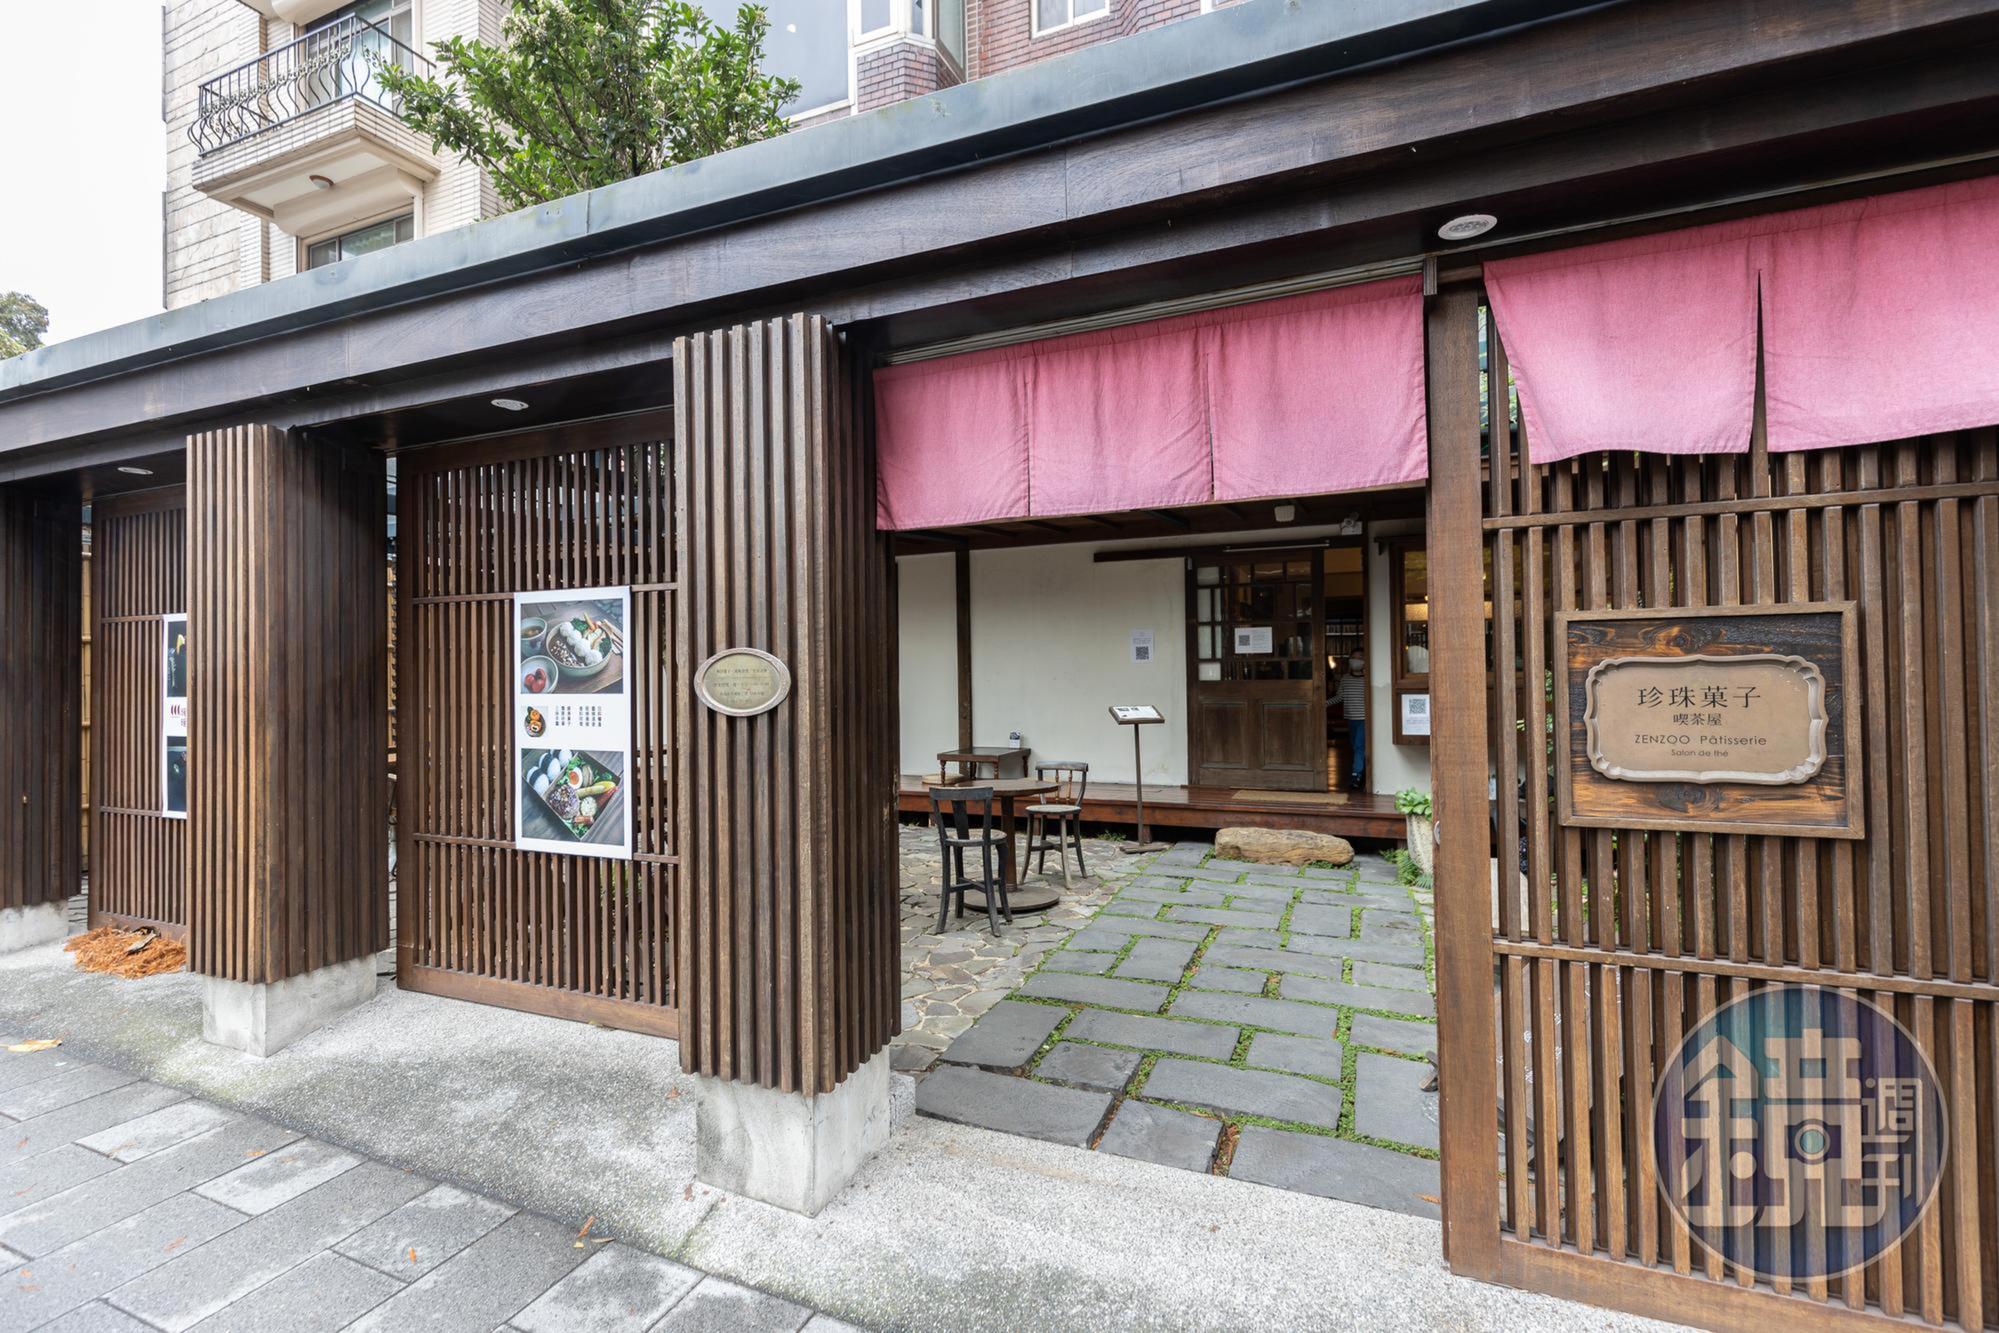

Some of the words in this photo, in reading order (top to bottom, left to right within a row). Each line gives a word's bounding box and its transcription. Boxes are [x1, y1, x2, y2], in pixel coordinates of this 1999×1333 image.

[1637, 685, 1761, 709] 珍珠菓子
[1673, 713, 1723, 726] 喫茶屋
[1634, 734, 1690, 745] ZENZOO
[1700, 735, 1767, 746] Pâtisserie
[1671, 749, 1696, 757] Salon
[1698, 749, 1711, 757] de
